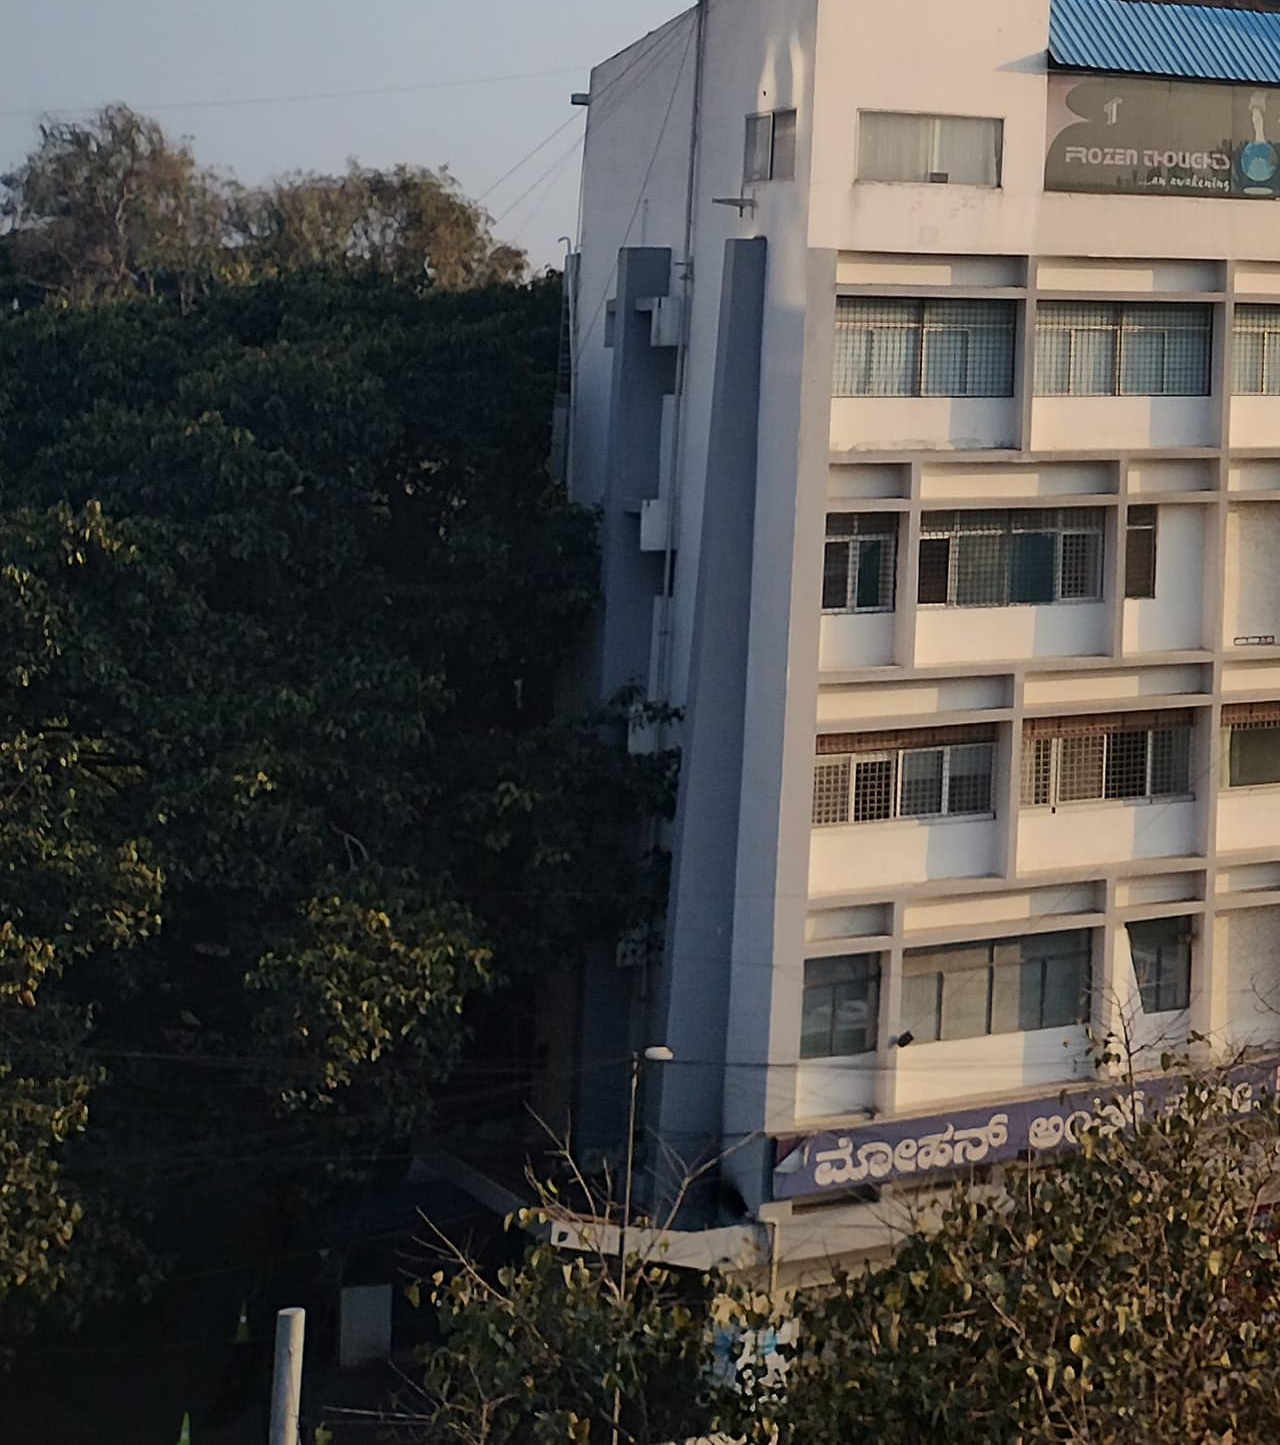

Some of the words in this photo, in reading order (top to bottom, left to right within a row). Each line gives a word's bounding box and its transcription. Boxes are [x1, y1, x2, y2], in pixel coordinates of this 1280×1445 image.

[1065, 146, 1138, 166] FROZEN
[1170, 174, 1230, 192] awakening
[814, 1113, 1009, 1186] ಮೋಹನ್
